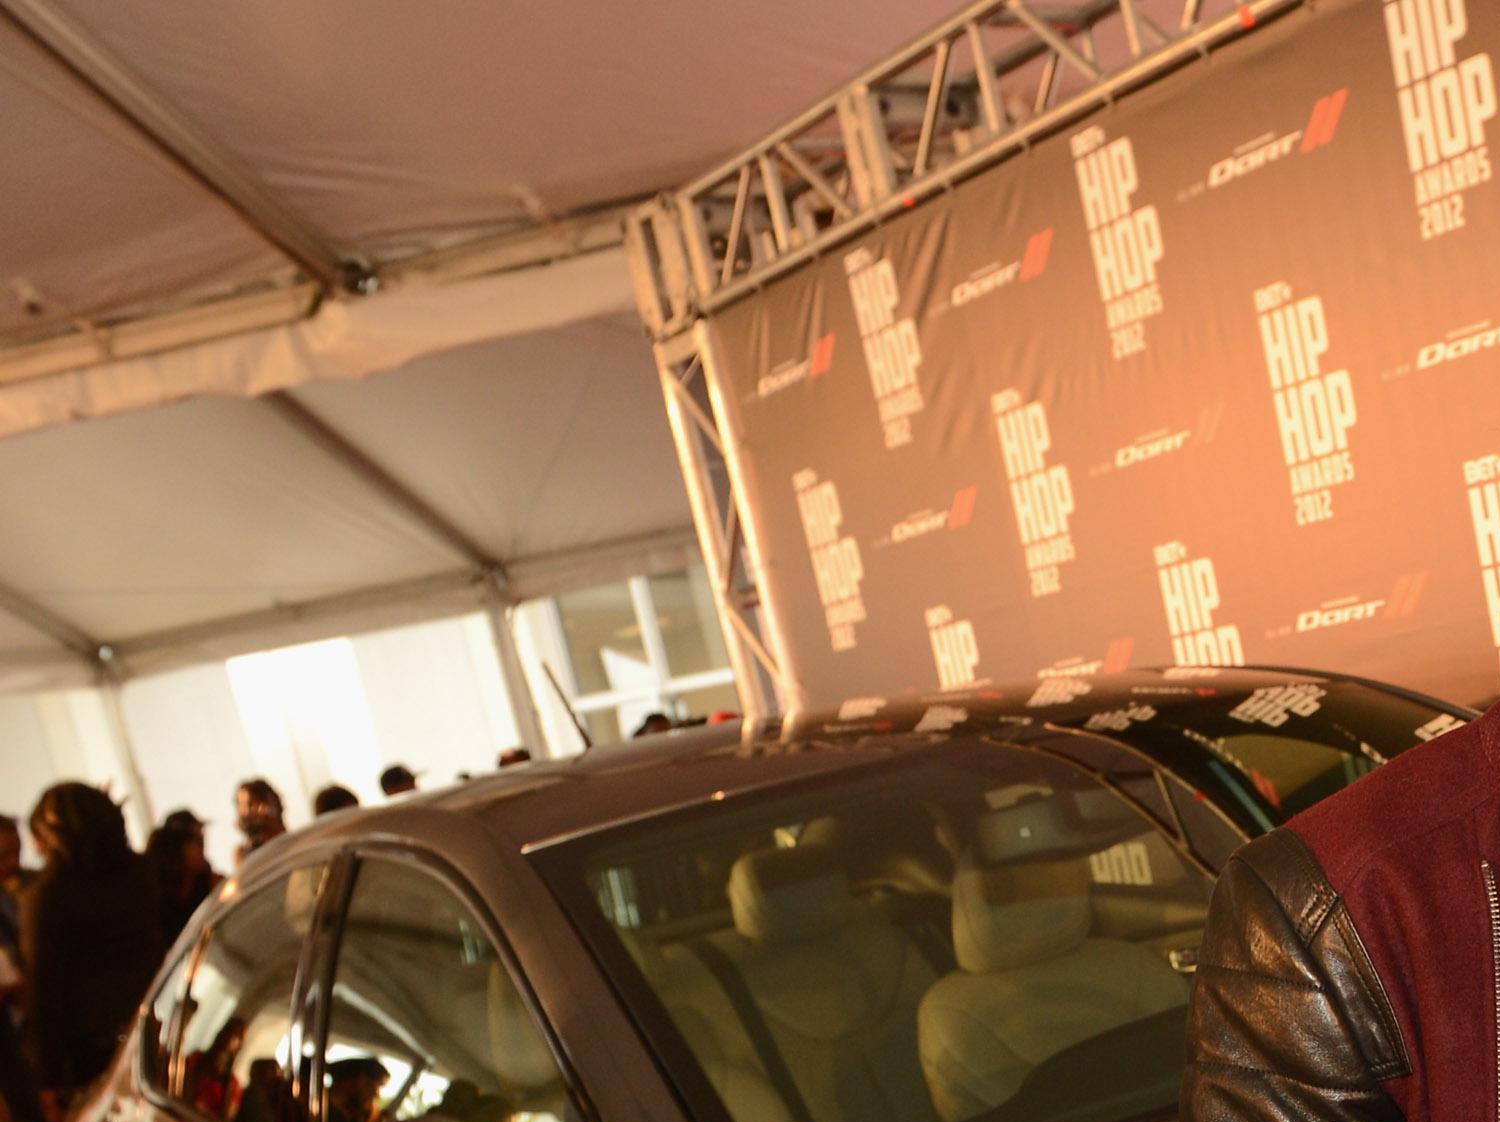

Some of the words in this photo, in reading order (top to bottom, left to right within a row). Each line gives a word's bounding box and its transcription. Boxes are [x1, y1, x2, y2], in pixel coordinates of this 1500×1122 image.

[1383, 0, 1468, 89] HIP
[1397, 52, 1498, 174] HOP
[1074, 135, 1138, 232] HIP
[1413, 145, 1493, 207] AWARDS
[1417, 192, 1466, 241] 2012
[1089, 203, 1164, 302] HOP
[1258, 294, 1329, 390] HIP
[996, 399, 1051, 481] HIP
[1273, 368, 1357, 467] HOP
[1010, 462, 1076, 545] HOP
[1288, 450, 1355, 496] AWARDS
[1293, 488, 1335, 527] 2012
[1158, 556, 1220, 637] HIP
